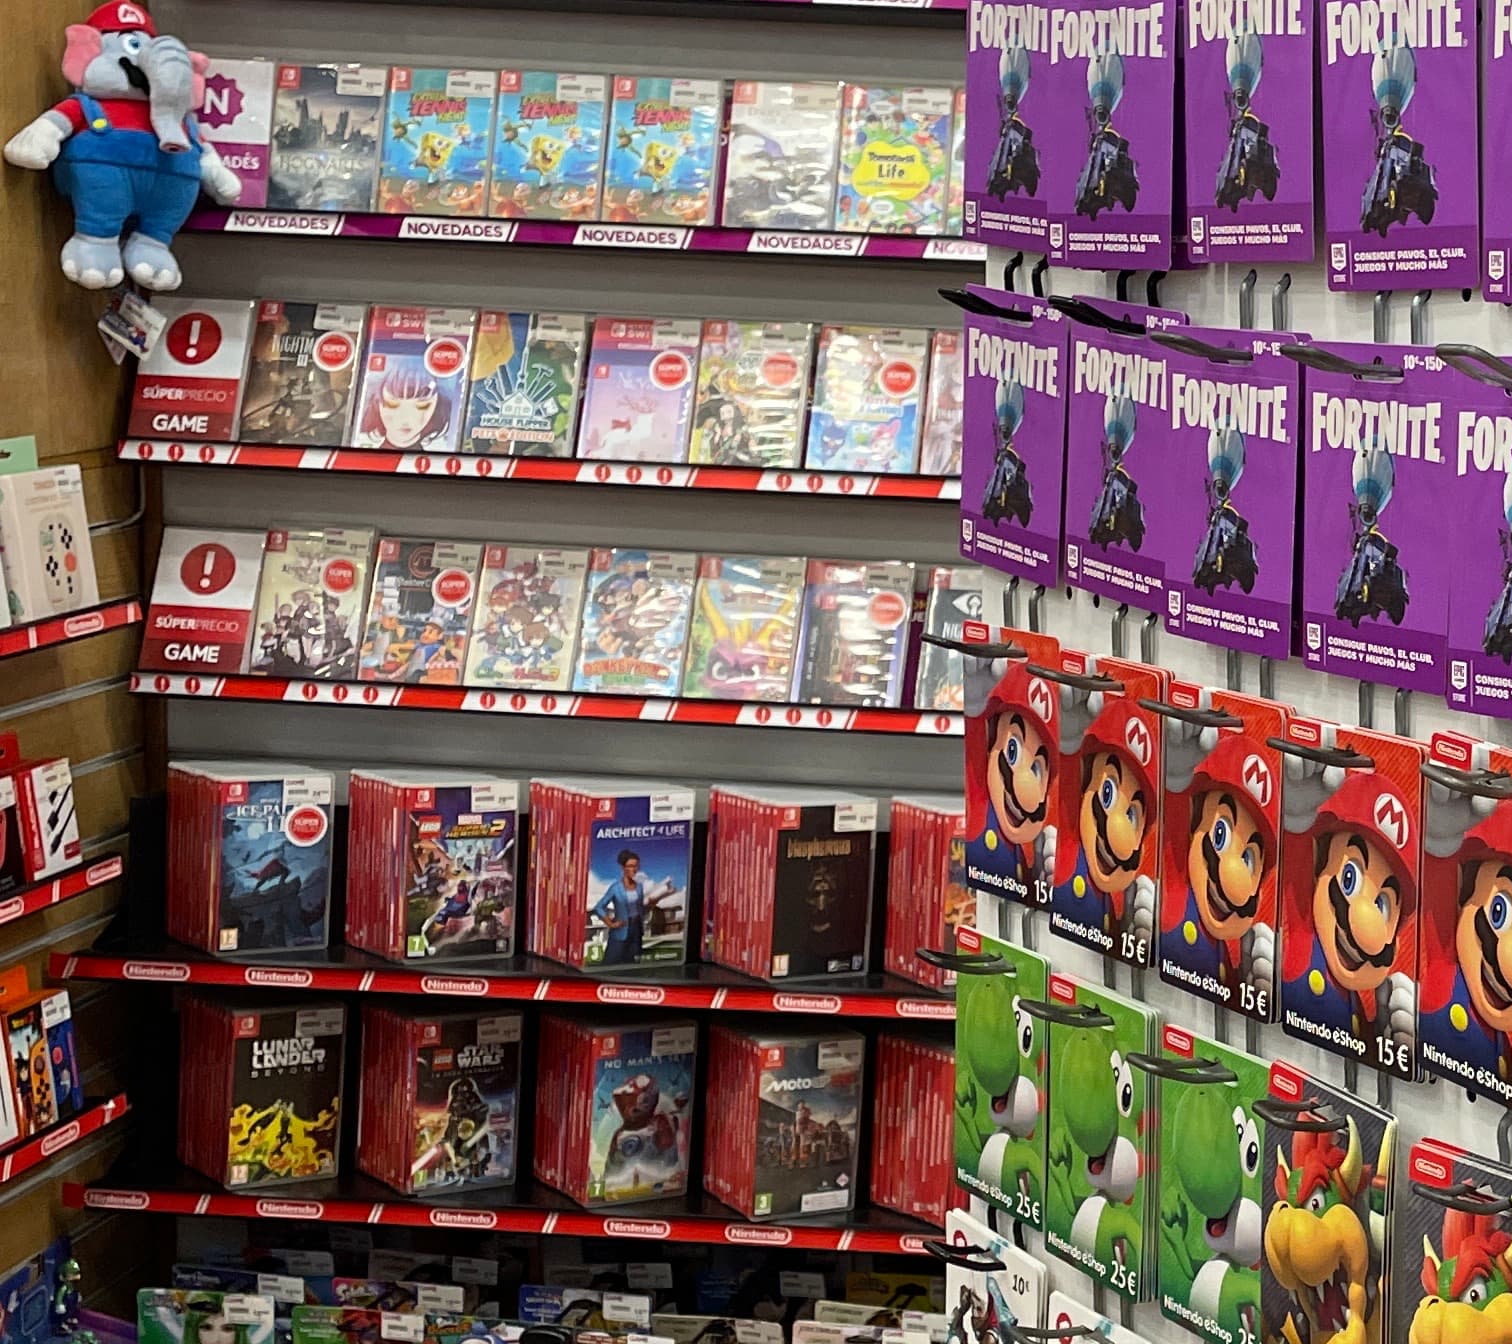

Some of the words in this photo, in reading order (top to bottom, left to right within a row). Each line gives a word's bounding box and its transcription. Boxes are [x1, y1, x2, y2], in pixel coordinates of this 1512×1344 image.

[969, 0, 1048, 54] FORTNIT
[1050, 1, 1167, 65] FORTNITE
[877, 164, 905, 179] Life
[234, 214, 328, 231] NOVEDADES
[407, 221, 503, 238] NOVEDADES
[581, 229, 677, 244] NOVEDADES
[757, 236, 853, 252] NOVEDADES
[968, 328, 1060, 398] FORTNITE
[153, 415, 208, 433] GAME
[1172, 373, 1291, 443] FORTNITE
[1312, 391, 1446, 464] FORTNITE
[164, 644, 220, 663] GAME
[596, 825, 655, 842] ARCHITECT
[968, 865, 1002, 888] Nintendo
[1003, 875, 1028, 898] eShop
[1052, 912, 1088, 938] Nintendo
[1088, 925, 1114, 950] eShop
[1162, 958, 1202, 987] Nintendo
[1202, 972, 1231, 1000] eShop
[1286, 1009, 1332, 1042] Nintendo
[1333, 1025, 1366, 1056] eShop
[251, 1065, 325, 1078] BEYOND
[1048, 1230, 1082, 1262] Nintendo
[1082, 1250, 1107, 1277] eShop
